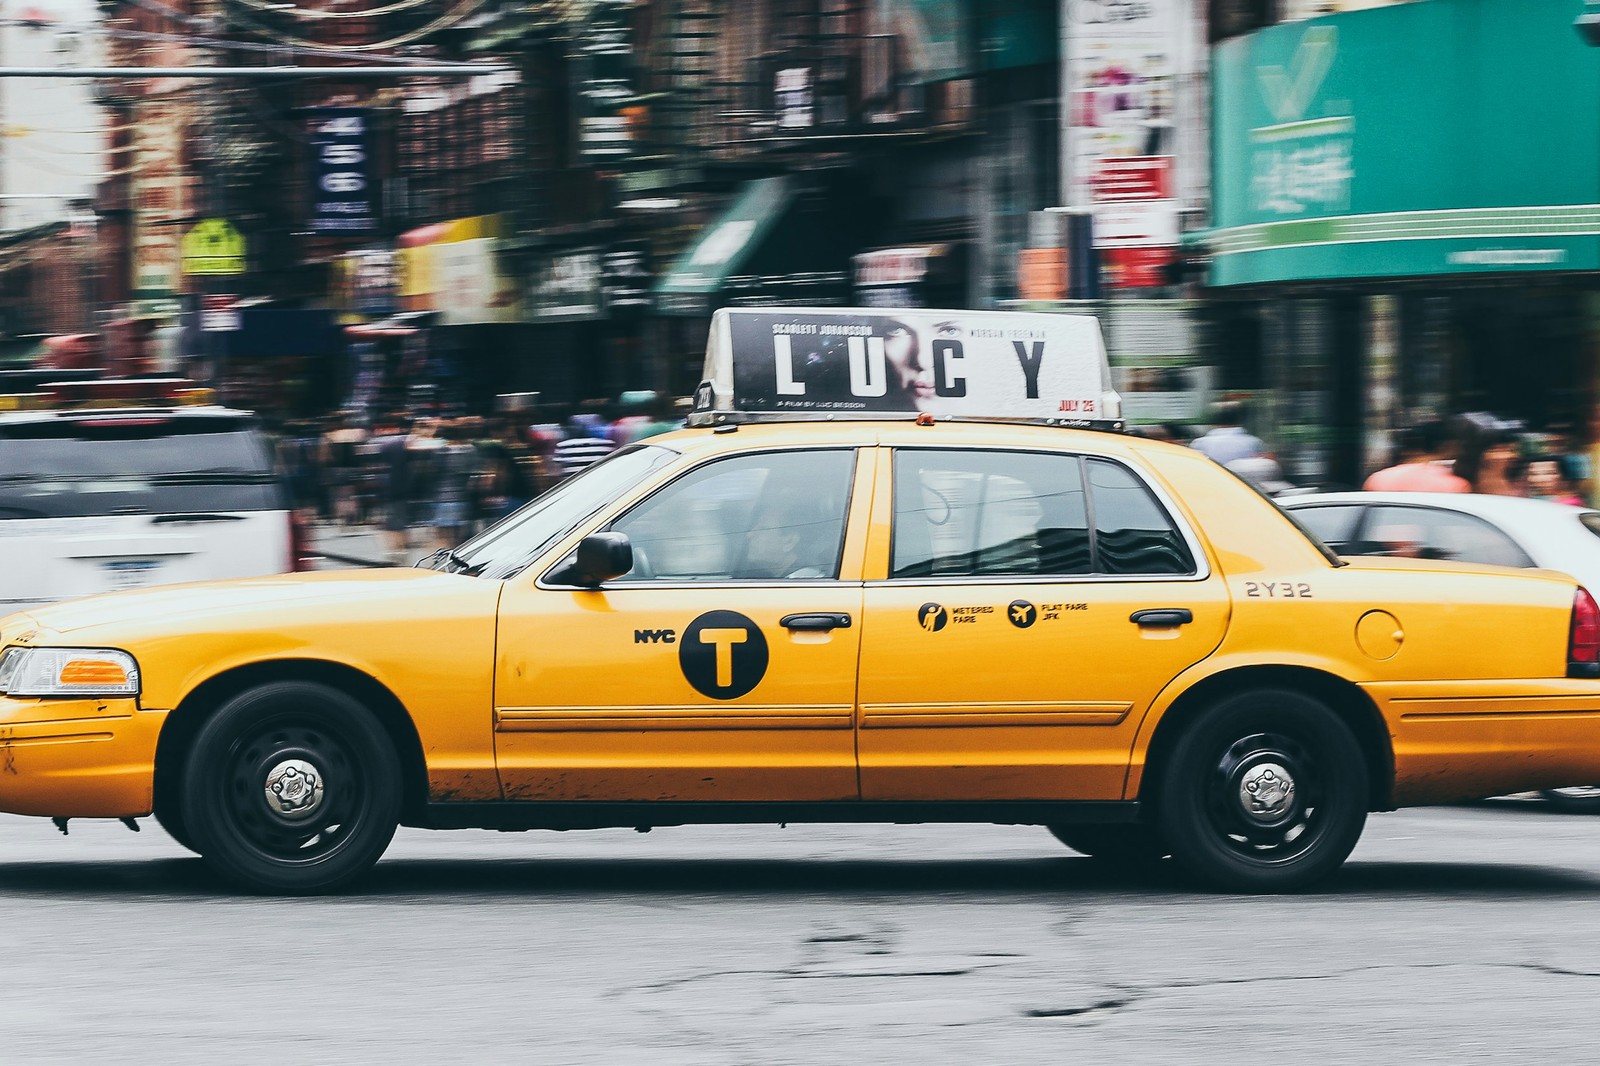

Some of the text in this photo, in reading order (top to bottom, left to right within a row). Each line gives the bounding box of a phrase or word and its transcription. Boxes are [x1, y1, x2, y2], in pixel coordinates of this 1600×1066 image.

[772, 323, 873, 336] SCARLETT JOHANSSON
[774, 334, 1045, 399] LUCY
[1058, 399, 1095, 412] JULY 25
[1245, 581, 1312, 598] 2Y32
[953, 606, 994, 615] METERED
[1041, 603, 1089, 612] FLAT FARE
[953, 615, 977, 624] FARE
[1042, 613, 1059, 621] JFK
[634, 629, 676, 644] NYC
